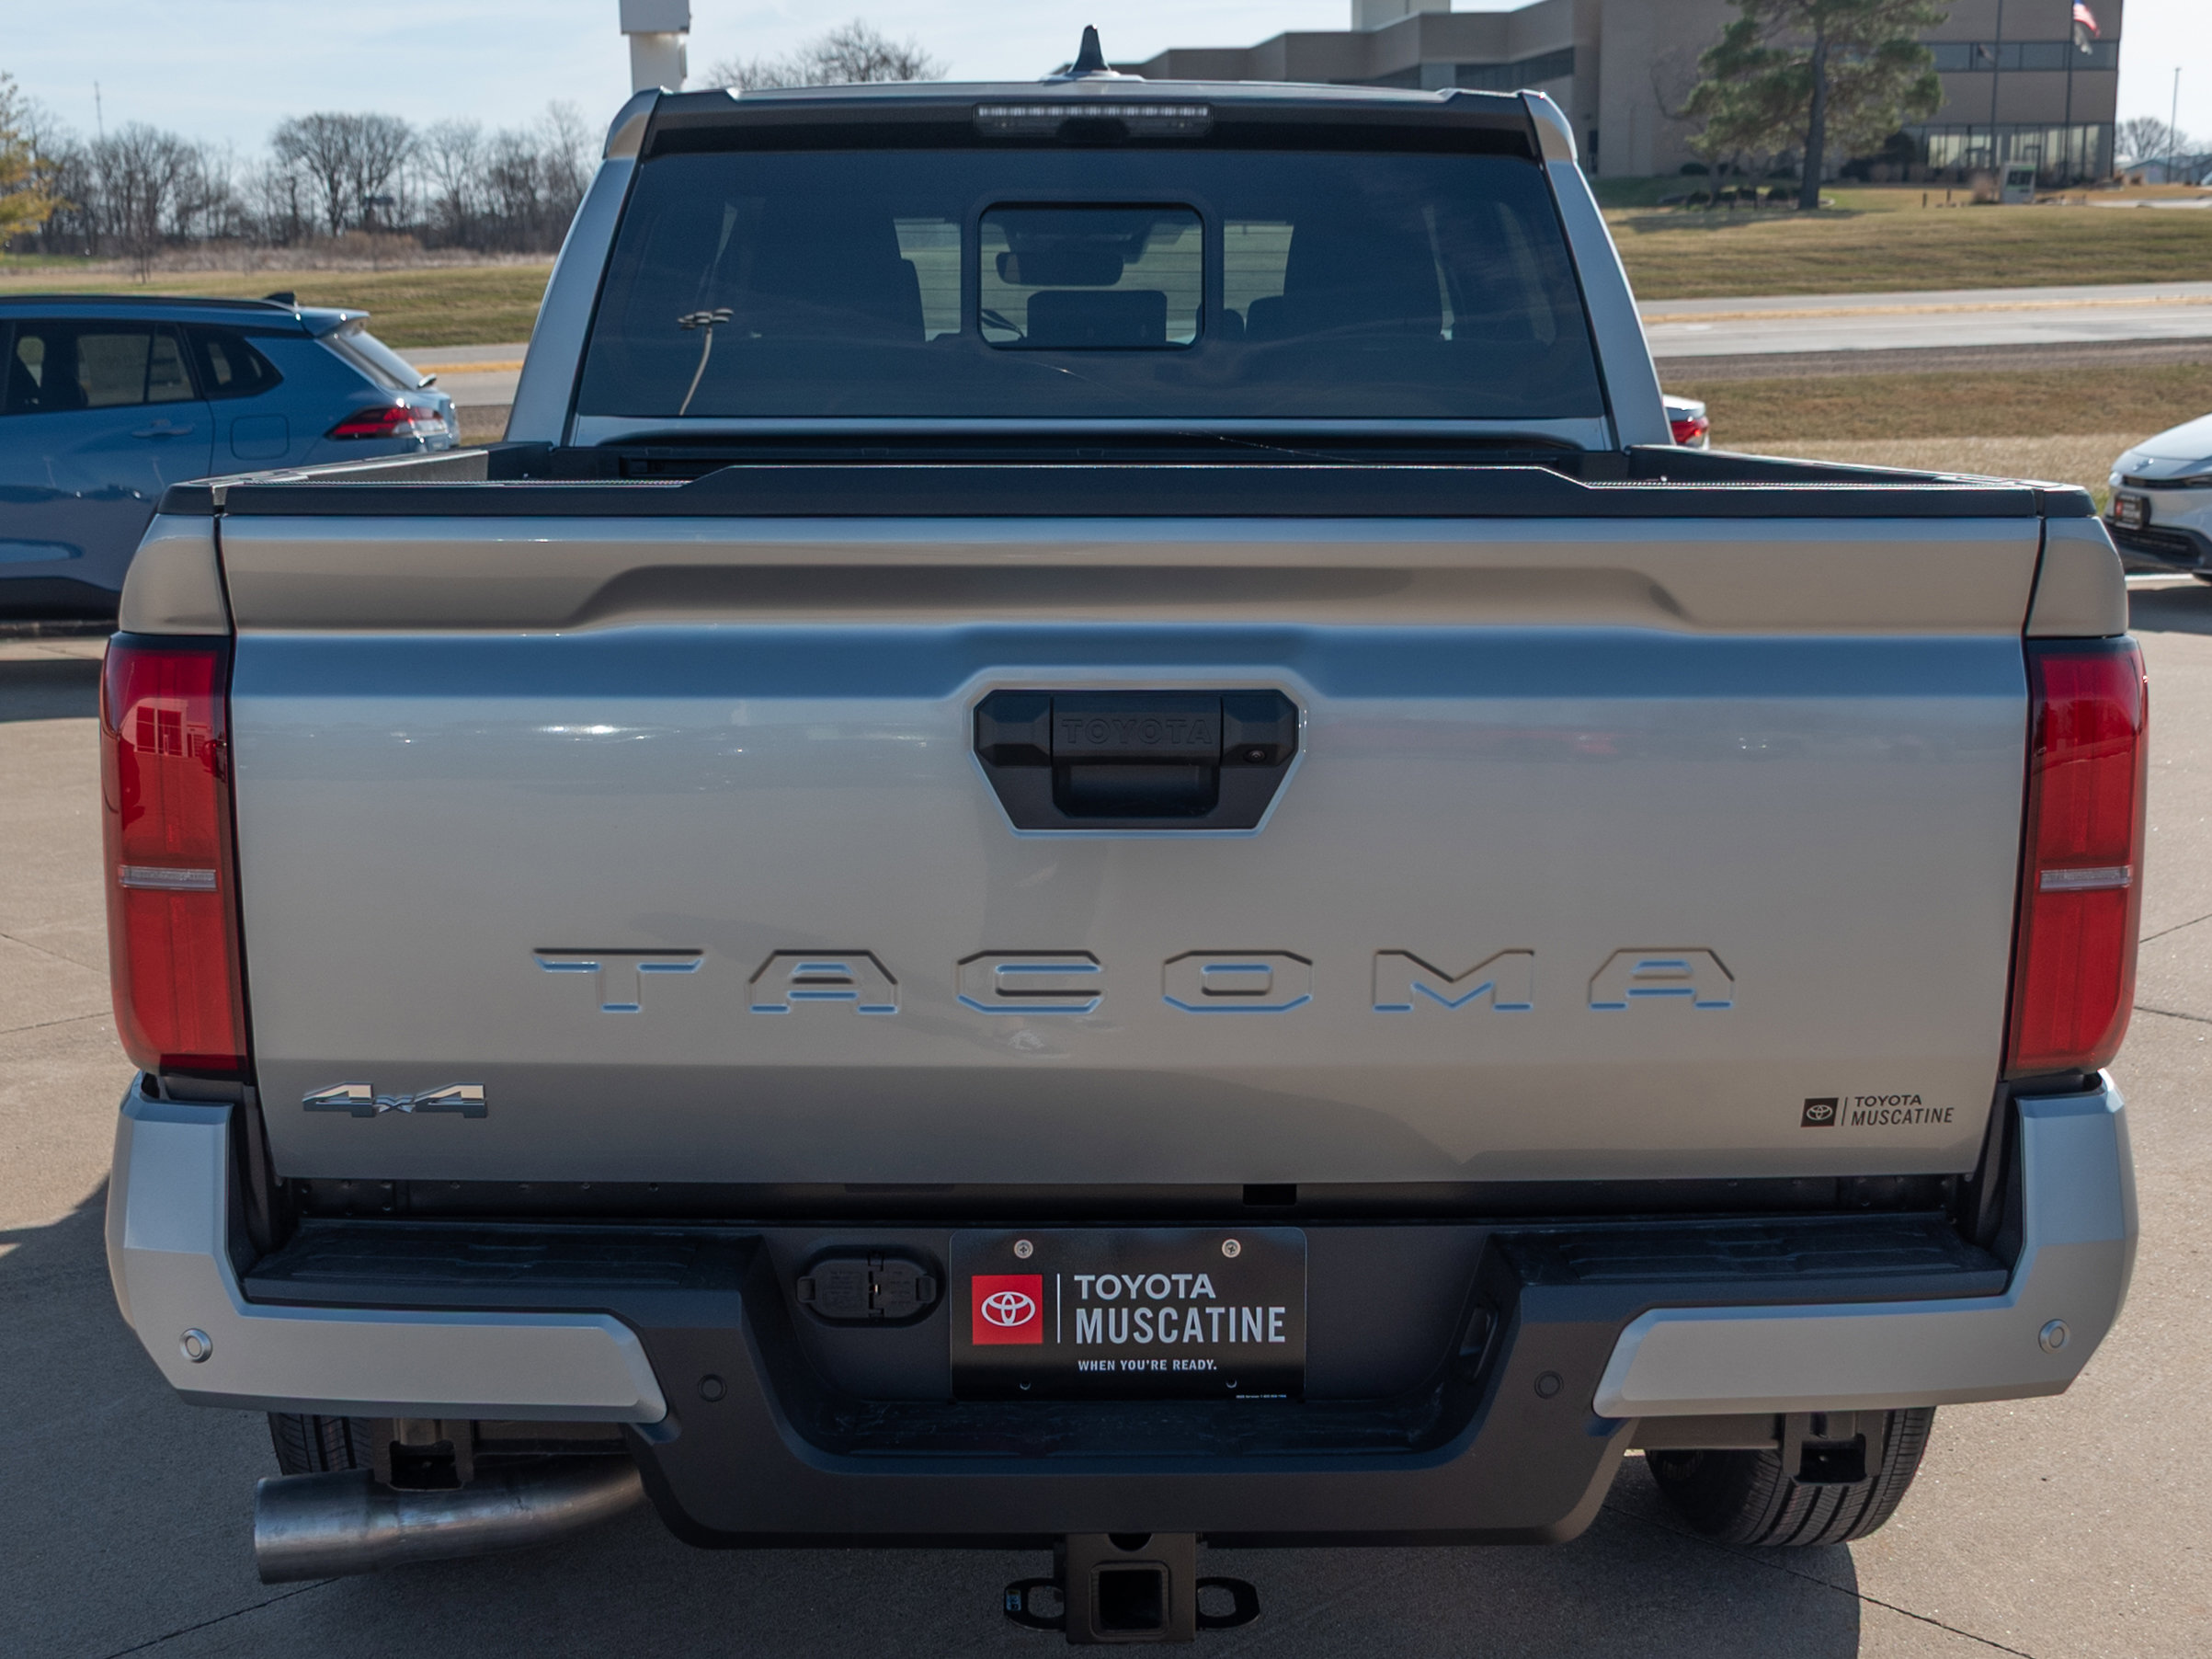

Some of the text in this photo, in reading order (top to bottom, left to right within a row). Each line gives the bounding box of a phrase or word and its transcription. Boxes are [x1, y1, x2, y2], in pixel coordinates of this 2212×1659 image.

[1061, 716, 1213, 745] TOYOTA
[532, 947, 1736, 1013] TACOMA
[1854, 1094, 1921, 1107] TOYOTA
[1851, 1107, 1955, 1127] MUSCATINE
[1074, 1274, 1216, 1300] TOYOTA
[1075, 1307, 1286, 1344] MUSCATINE
[1077, 1359, 1217, 1371] WHEN YOU'RE READY.
